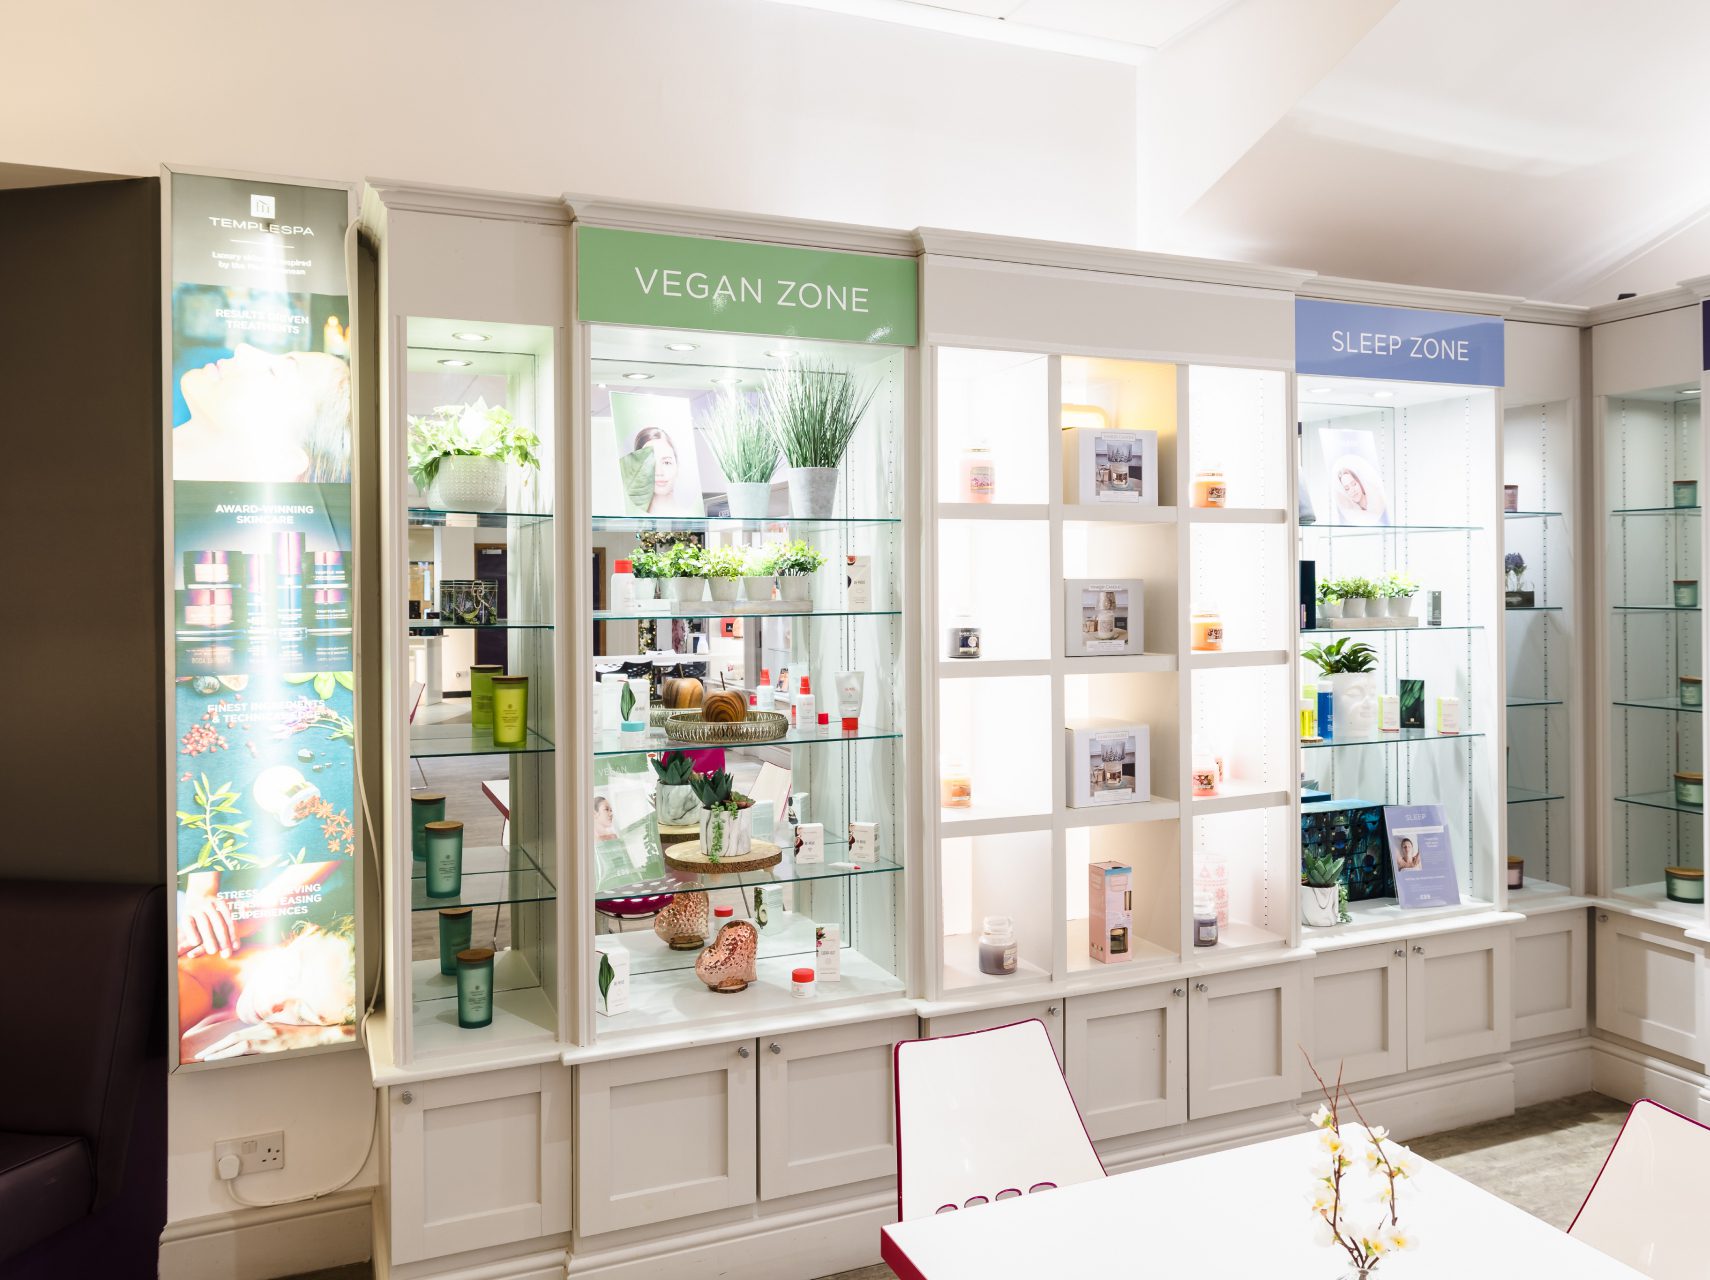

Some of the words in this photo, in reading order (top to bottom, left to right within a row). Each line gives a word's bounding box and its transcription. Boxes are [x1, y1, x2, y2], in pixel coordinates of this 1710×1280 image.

[209, 216, 315, 237] TEMPLESPA
[634, 266, 762, 304] VEGAN
[777, 279, 869, 313] ZONE
[1331, 330, 1402, 356] SLEEP
[1409, 336, 1469, 361] ZONE
[215, 504, 314, 514] AWARD-WINNING
[236, 515, 294, 525] SKINCARE
[207, 703, 249, 713] FINEST
[598, 765, 628, 777] VEGAN
[231, 906, 308, 920] EXPERIENCES
